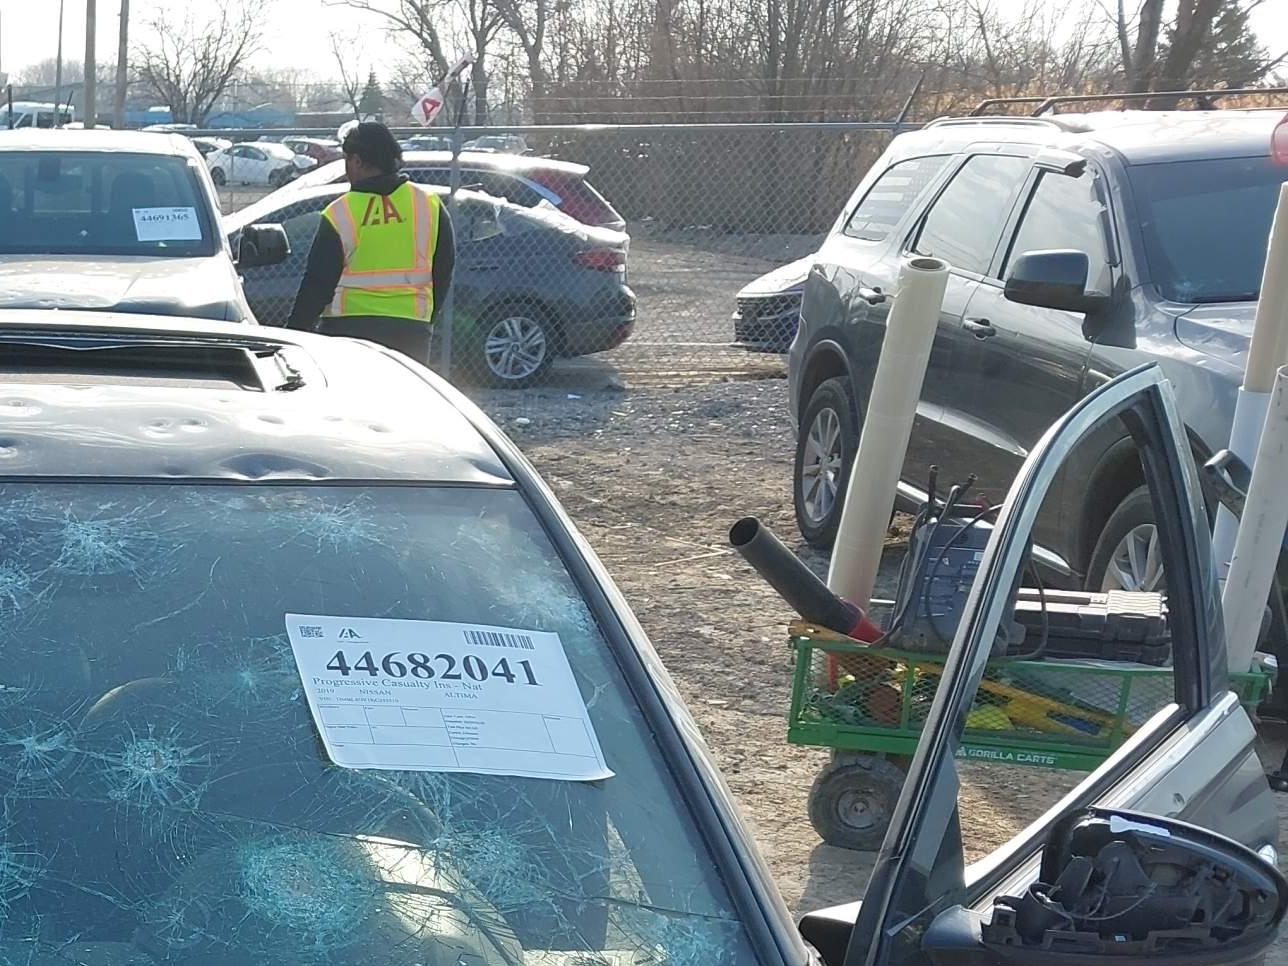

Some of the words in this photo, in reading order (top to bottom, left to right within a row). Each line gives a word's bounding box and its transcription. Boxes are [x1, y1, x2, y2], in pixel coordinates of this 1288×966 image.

[326, 650, 543, 687] 44682041
[313, 677, 378, 688] Progressive
[382, 679, 430, 690] Casualty
[434, 680, 452, 689] Ins
[462, 682, 483, 691] Nat
[968, 749, 1013, 760] GORILLA
[1017, 753, 1056, 764] CARTS
